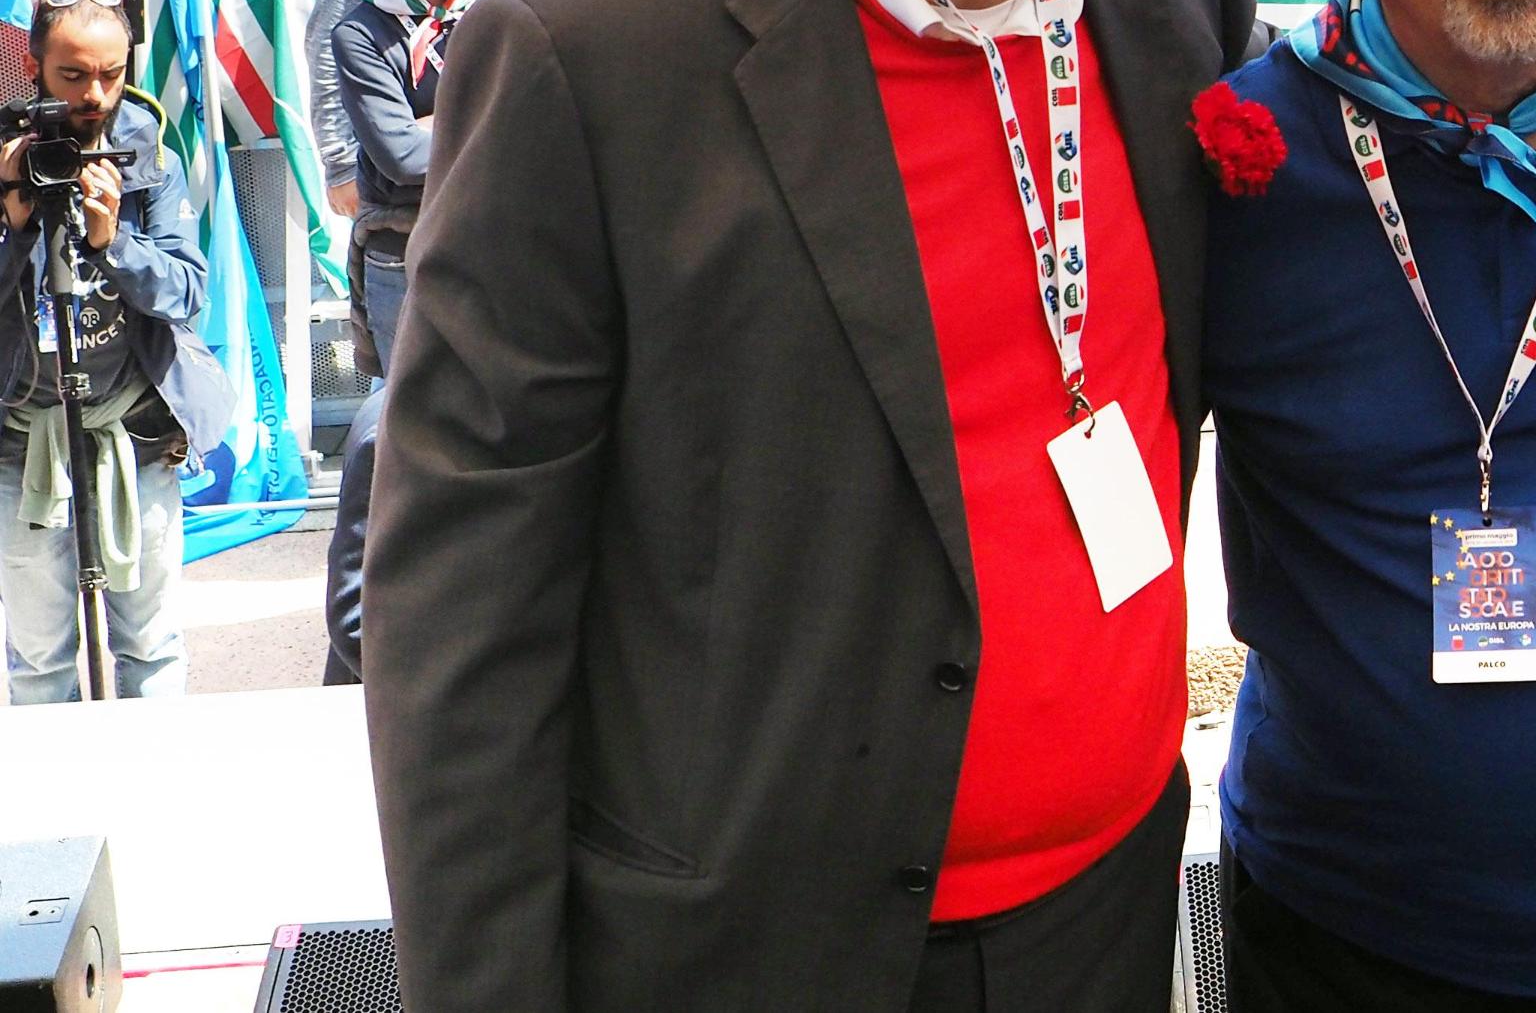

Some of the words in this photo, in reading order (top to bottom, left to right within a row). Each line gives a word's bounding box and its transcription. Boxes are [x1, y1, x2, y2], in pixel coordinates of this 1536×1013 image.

[1448, 623, 1462, 632] LA
[1461, 622, 1497, 631] NOSTRA
[1499, 621, 1535, 630] EUROPA
